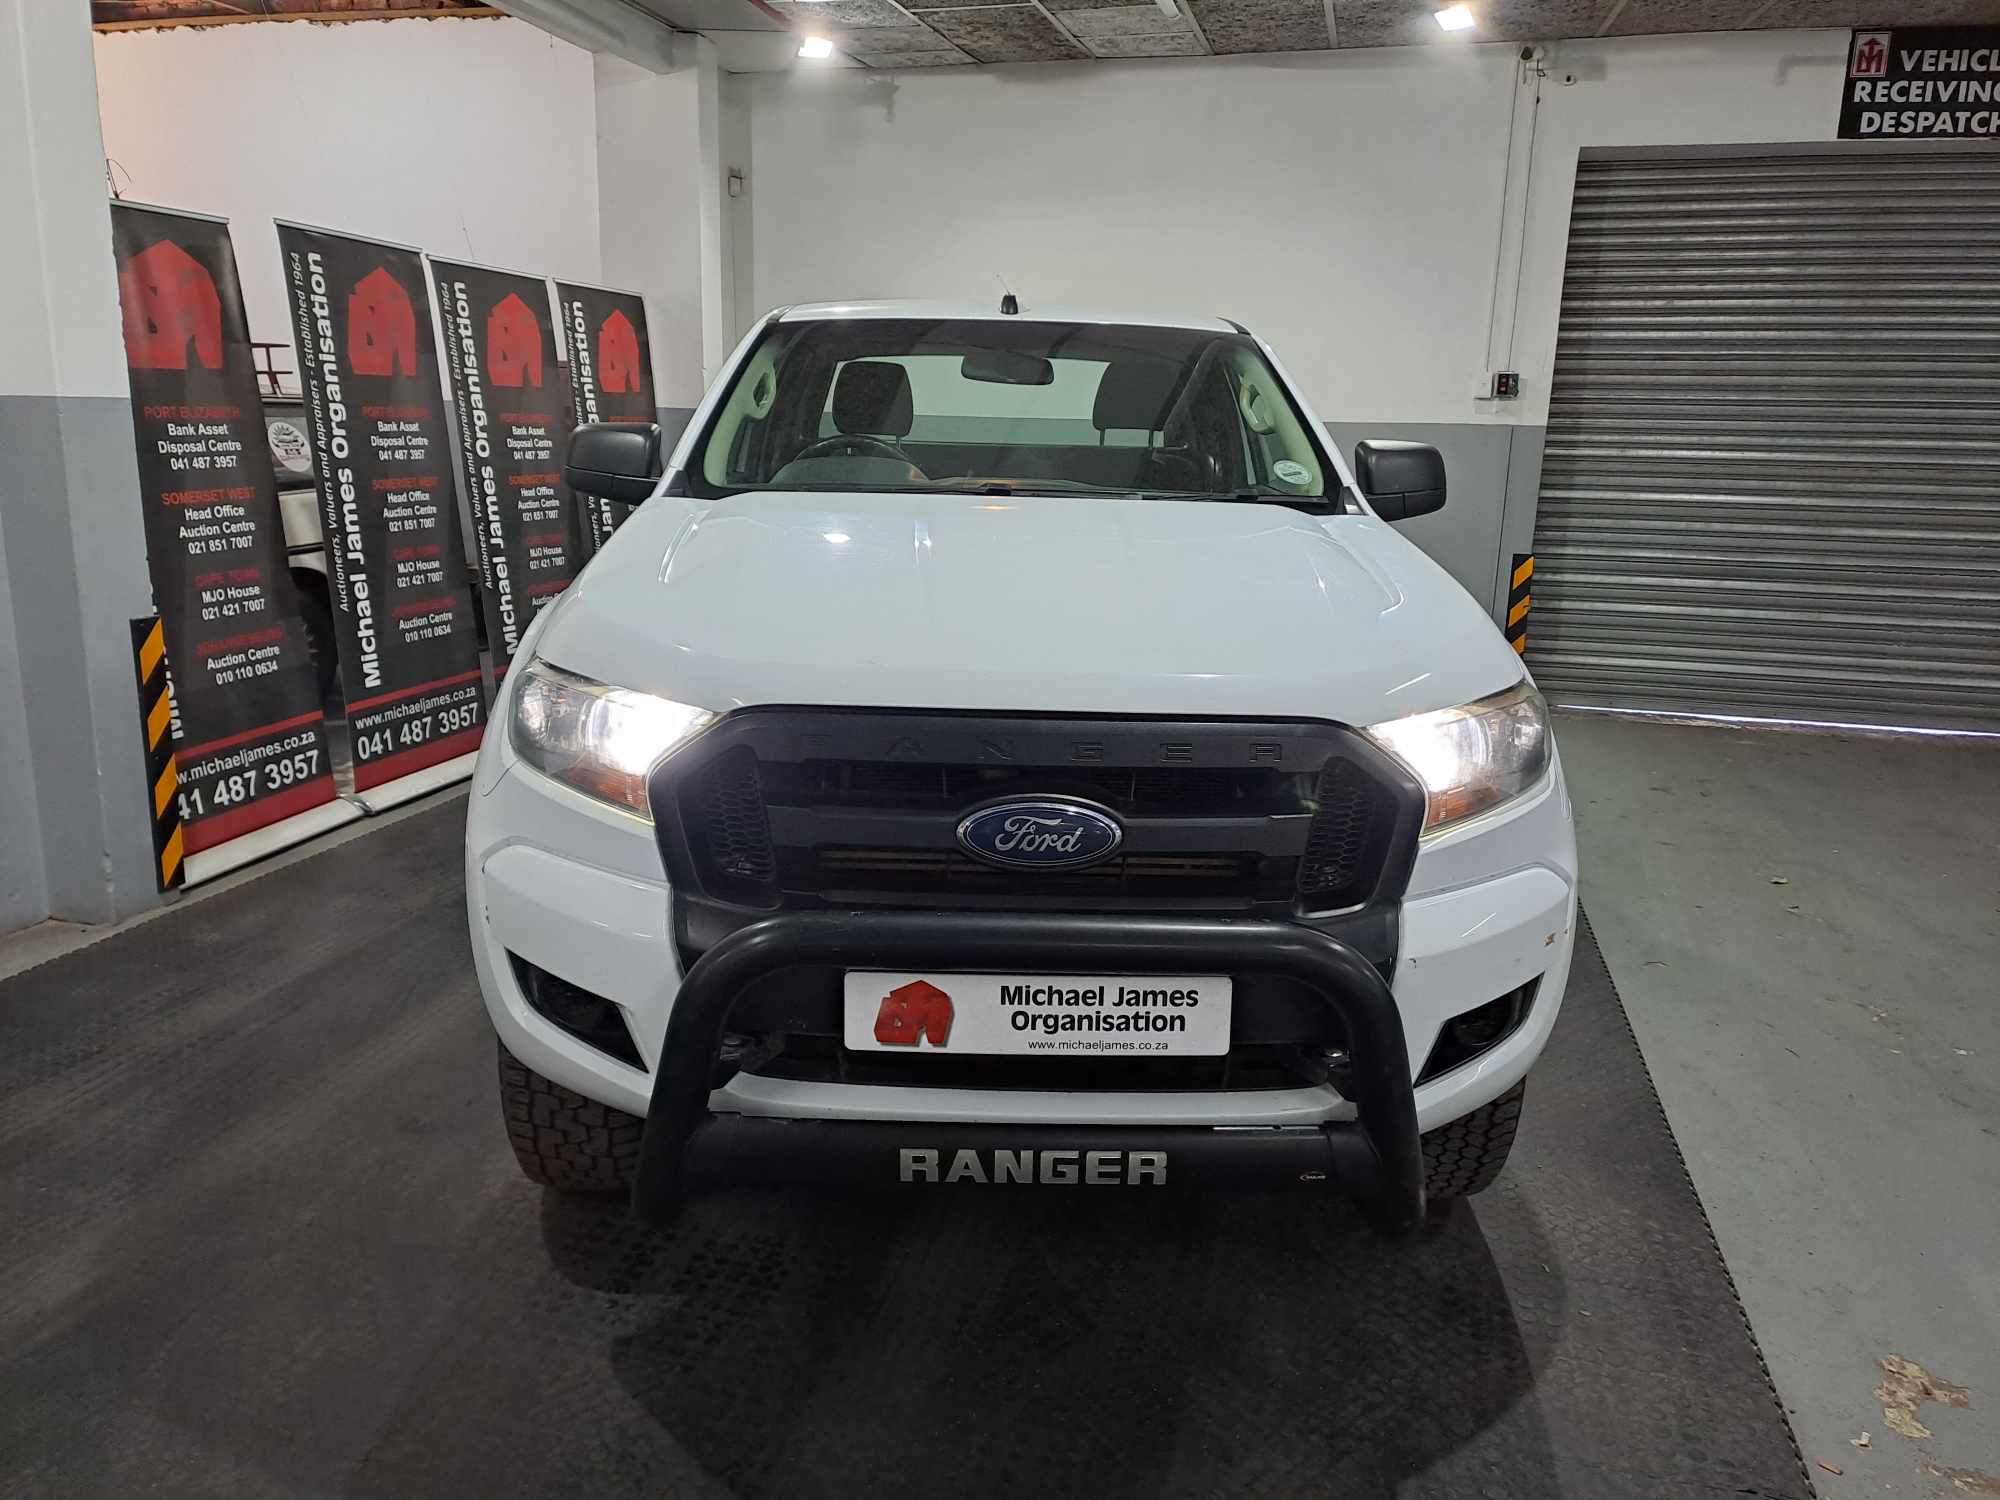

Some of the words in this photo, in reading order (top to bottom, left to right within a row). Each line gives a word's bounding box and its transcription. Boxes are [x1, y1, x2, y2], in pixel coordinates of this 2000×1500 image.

[291, 252, 304, 286] 1964
[295, 290, 315, 368] Established
[307, 252, 349, 460] Organisation
[453, 281, 491, 458] Organisation
[309, 379, 327, 450] Appraisers
[167, 423, 196, 436] Bank
[198, 423, 229, 435] Asset
[377, 421, 398, 432] Bank
[399, 421, 420, 432] Asset
[158, 440, 206, 456] Disposal
[208, 440, 242, 452] Centre
[370, 435, 405, 448] Disposal
[406, 435, 429, 446] Centre
[170, 458, 189, 470] 041
[192, 457, 211, 469] 487
[214, 456, 237, 468] 3957
[318, 451, 331, 478] and
[378, 449, 392, 460] 041
[394, 449, 408, 460] 487
[465, 451, 476, 474] and
[323, 482, 337, 529] Valuers
[387, 493, 408, 503] Head
[408, 490, 430, 502] Office
[470, 477, 482, 518] Valuers
[481, 466, 504, 549] James
[184, 507, 212, 521] Head
[214, 505, 245, 518] Office
[338, 467, 365, 565] James
[383, 507, 413, 518] Auction
[414, 505, 438, 515] Centre
[179, 524, 220, 539] Auction
[222, 521, 256, 533] Centre
[389, 521, 402, 532] 021
[404, 519, 418, 531] 851
[419, 518, 435, 529] 7007
[188, 542, 206, 555] 021
[209, 539, 228, 552] 851
[230, 536, 253, 549] 7007
[331, 534, 350, 612] Auctioneers,
[397, 562, 415, 574] MJO
[416, 560, 441, 571] House
[397, 577, 410, 588] 021
[412, 575, 425, 585] 421
[427, 572, 443, 583] 7007
[202, 589, 225, 603] MJO
[227, 585, 260, 599] House
[492, 556, 519, 655] Michael
[202, 607, 220, 621] 021
[222, 604, 240, 617] 421
[243, 599, 265, 613] 7007
[399, 619, 428, 630] Auction
[429, 612, 453, 624] Centre
[350, 573, 382, 689] Michael
[405, 632, 419, 643] 010
[419, 628, 433, 639] 110
[207, 653, 246, 670] Auction
[248, 645, 280, 661] Centre
[216, 671, 234, 685] 010
[235, 667, 253, 681] 110
[255, 660, 278, 676] 0634
[355, 686, 476, 730] www.michaeljames.co.za
[357, 728, 393, 760] 041
[399, 716, 432, 745] 487
[438, 702, 479, 734] 3957
[213, 770, 257, 806] 487
[264, 749, 319, 790] 3957
[993, 815, 1084, 855] Ford
[1000, 985, 1106, 1008] Michael
[1111, 985, 1200, 1008] James
[1010, 1011, 1186, 1035] Organisation
[1028, 1040, 1169, 1052] www.michaeljames.co.za
[899, 1148, 1168, 1185] RANGER
